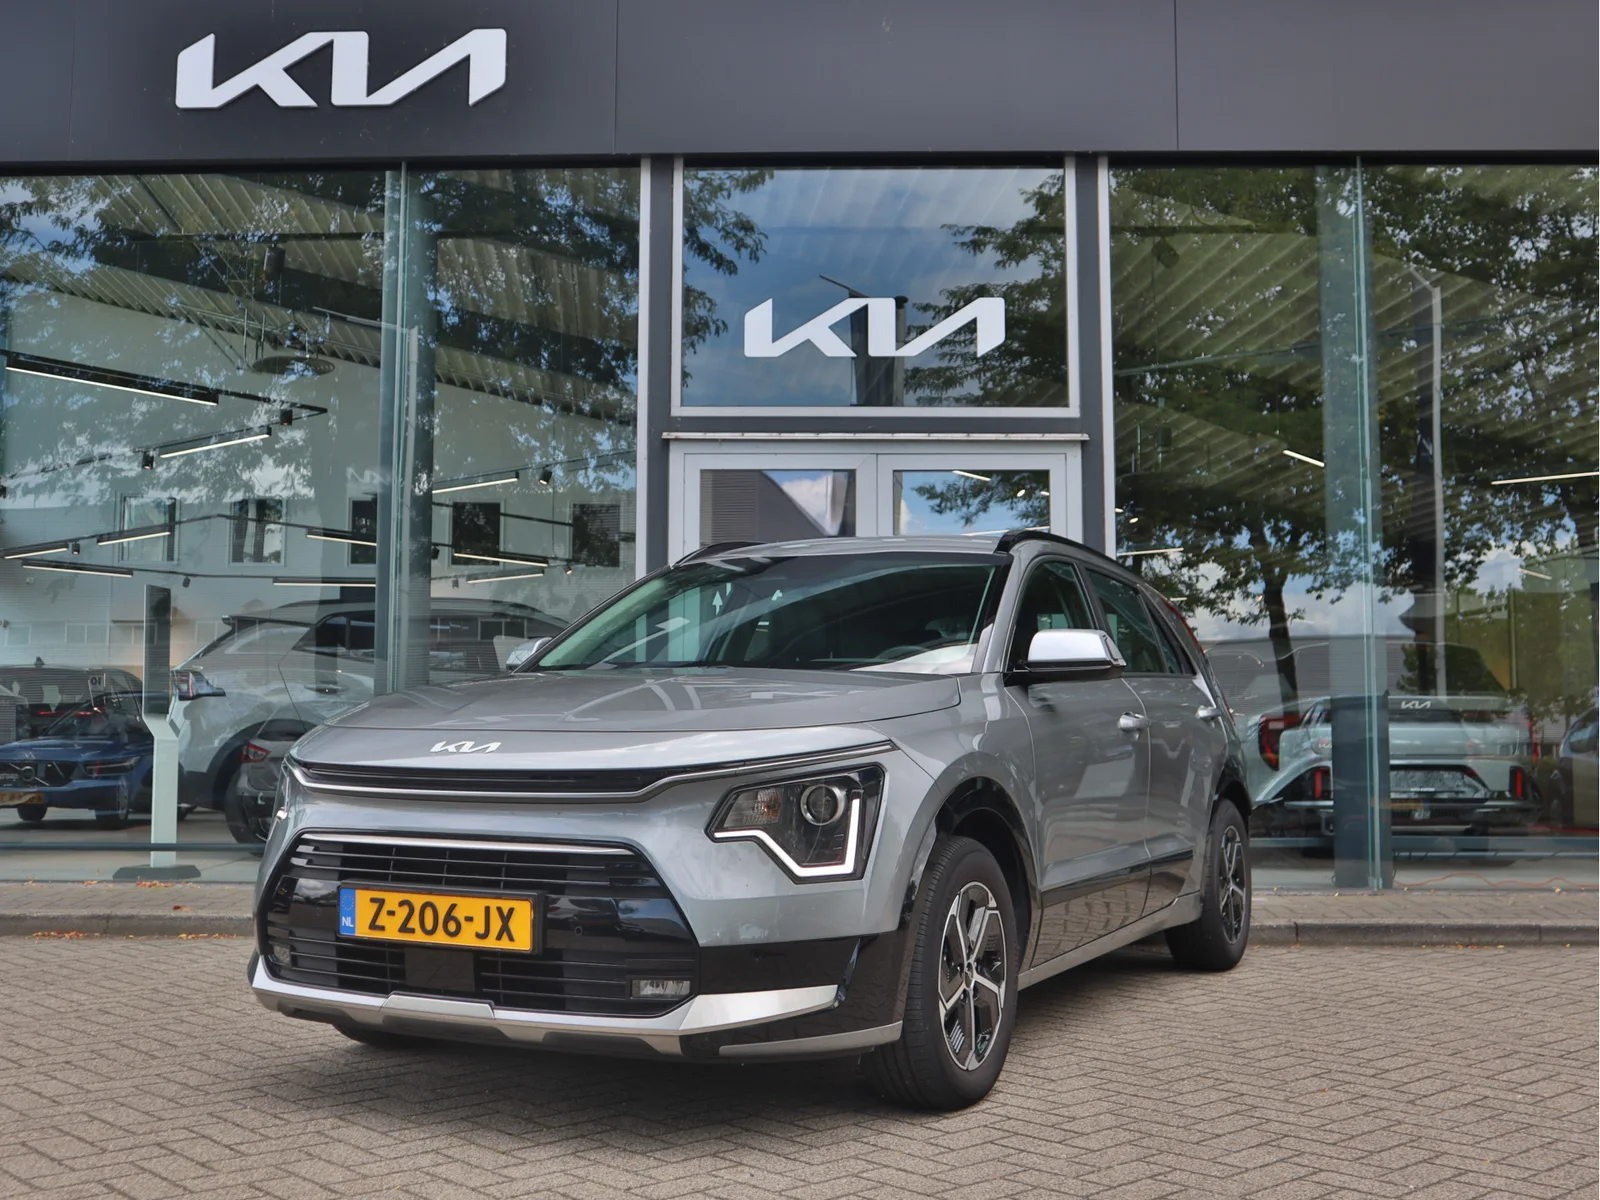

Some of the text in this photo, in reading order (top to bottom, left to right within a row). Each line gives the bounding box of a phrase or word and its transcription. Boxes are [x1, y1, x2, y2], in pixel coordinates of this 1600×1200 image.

[175, 28, 507, 109] KIA
[744, 297, 1006, 358] KIA
[1401, 700, 1431, 709] KIA
[430, 741, 502, 753] KIA
[342, 916, 354, 928] NL
[368, 897, 515, 942] Z-206-JX
